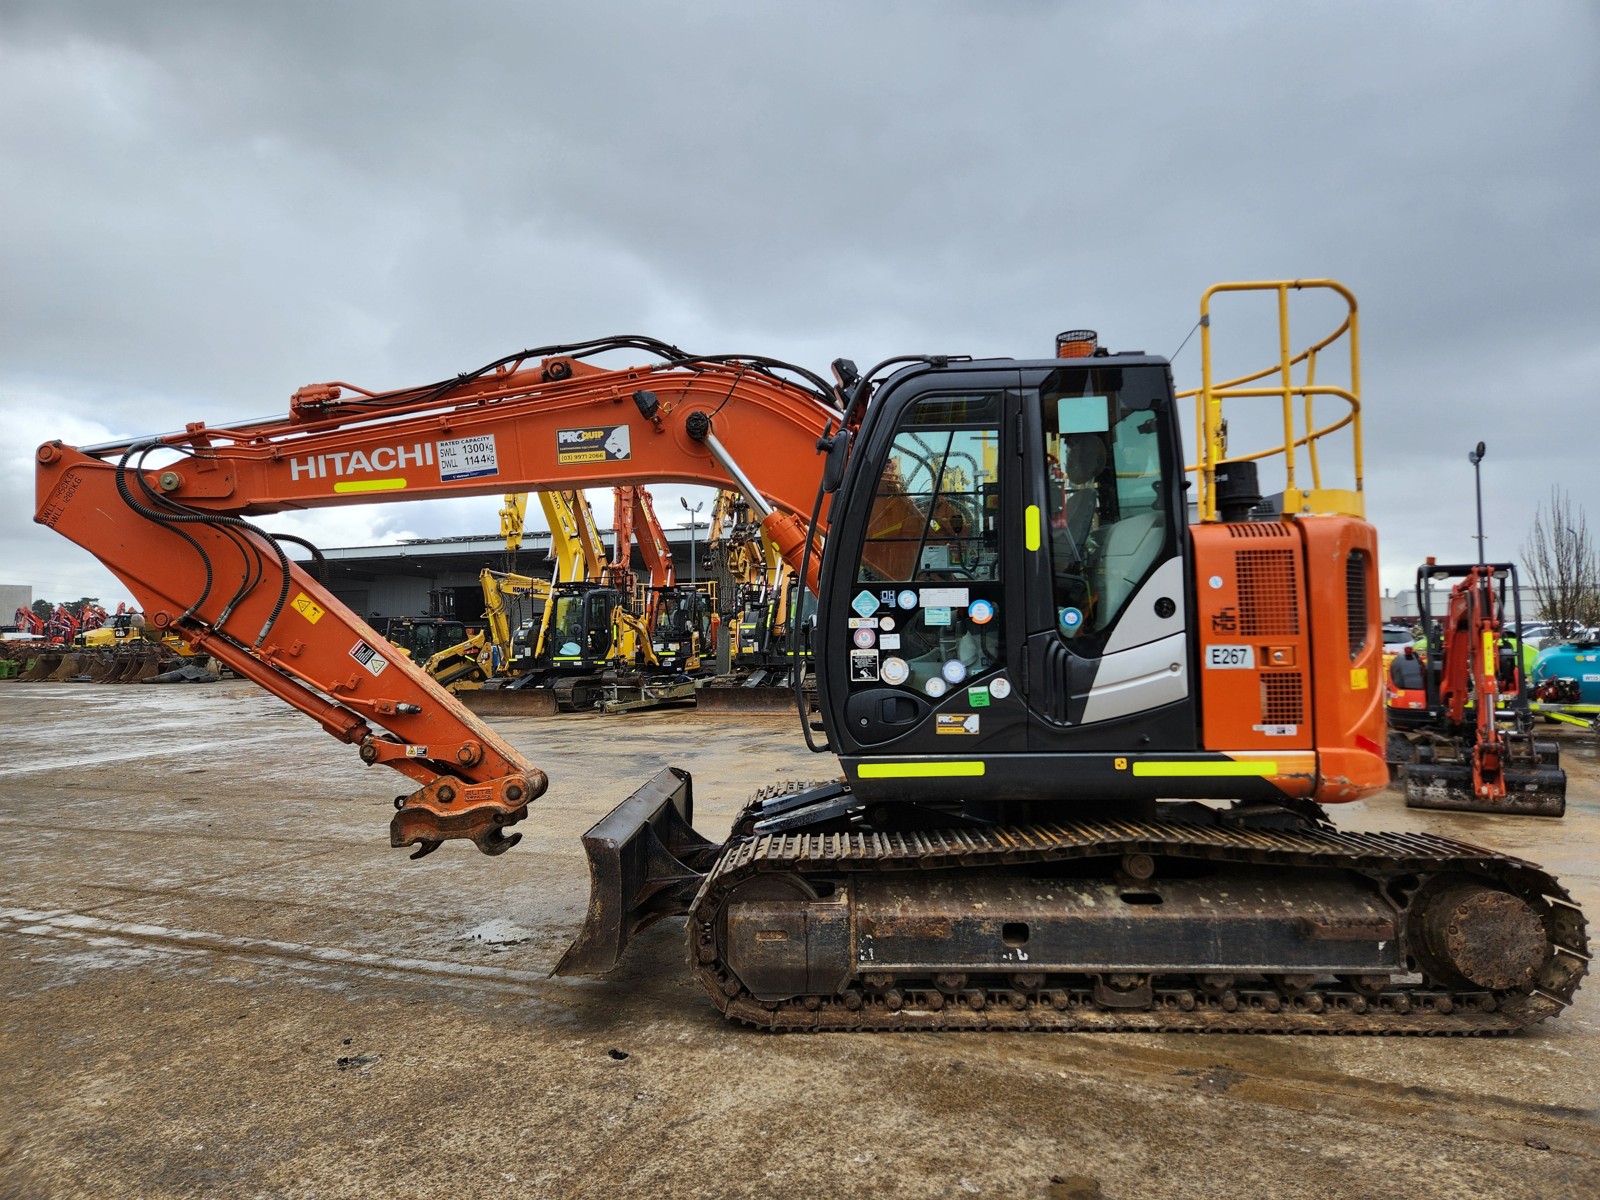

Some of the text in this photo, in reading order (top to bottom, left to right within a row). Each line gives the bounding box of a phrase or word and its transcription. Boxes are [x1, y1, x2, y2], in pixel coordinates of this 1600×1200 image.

[461, 436, 490, 444] CAPACITY
[440, 447, 457, 458] SWLL
[290, 442, 434, 481] HITACHI
[441, 459, 459, 469] DWLL
[1212, 648, 1248, 665] E267
